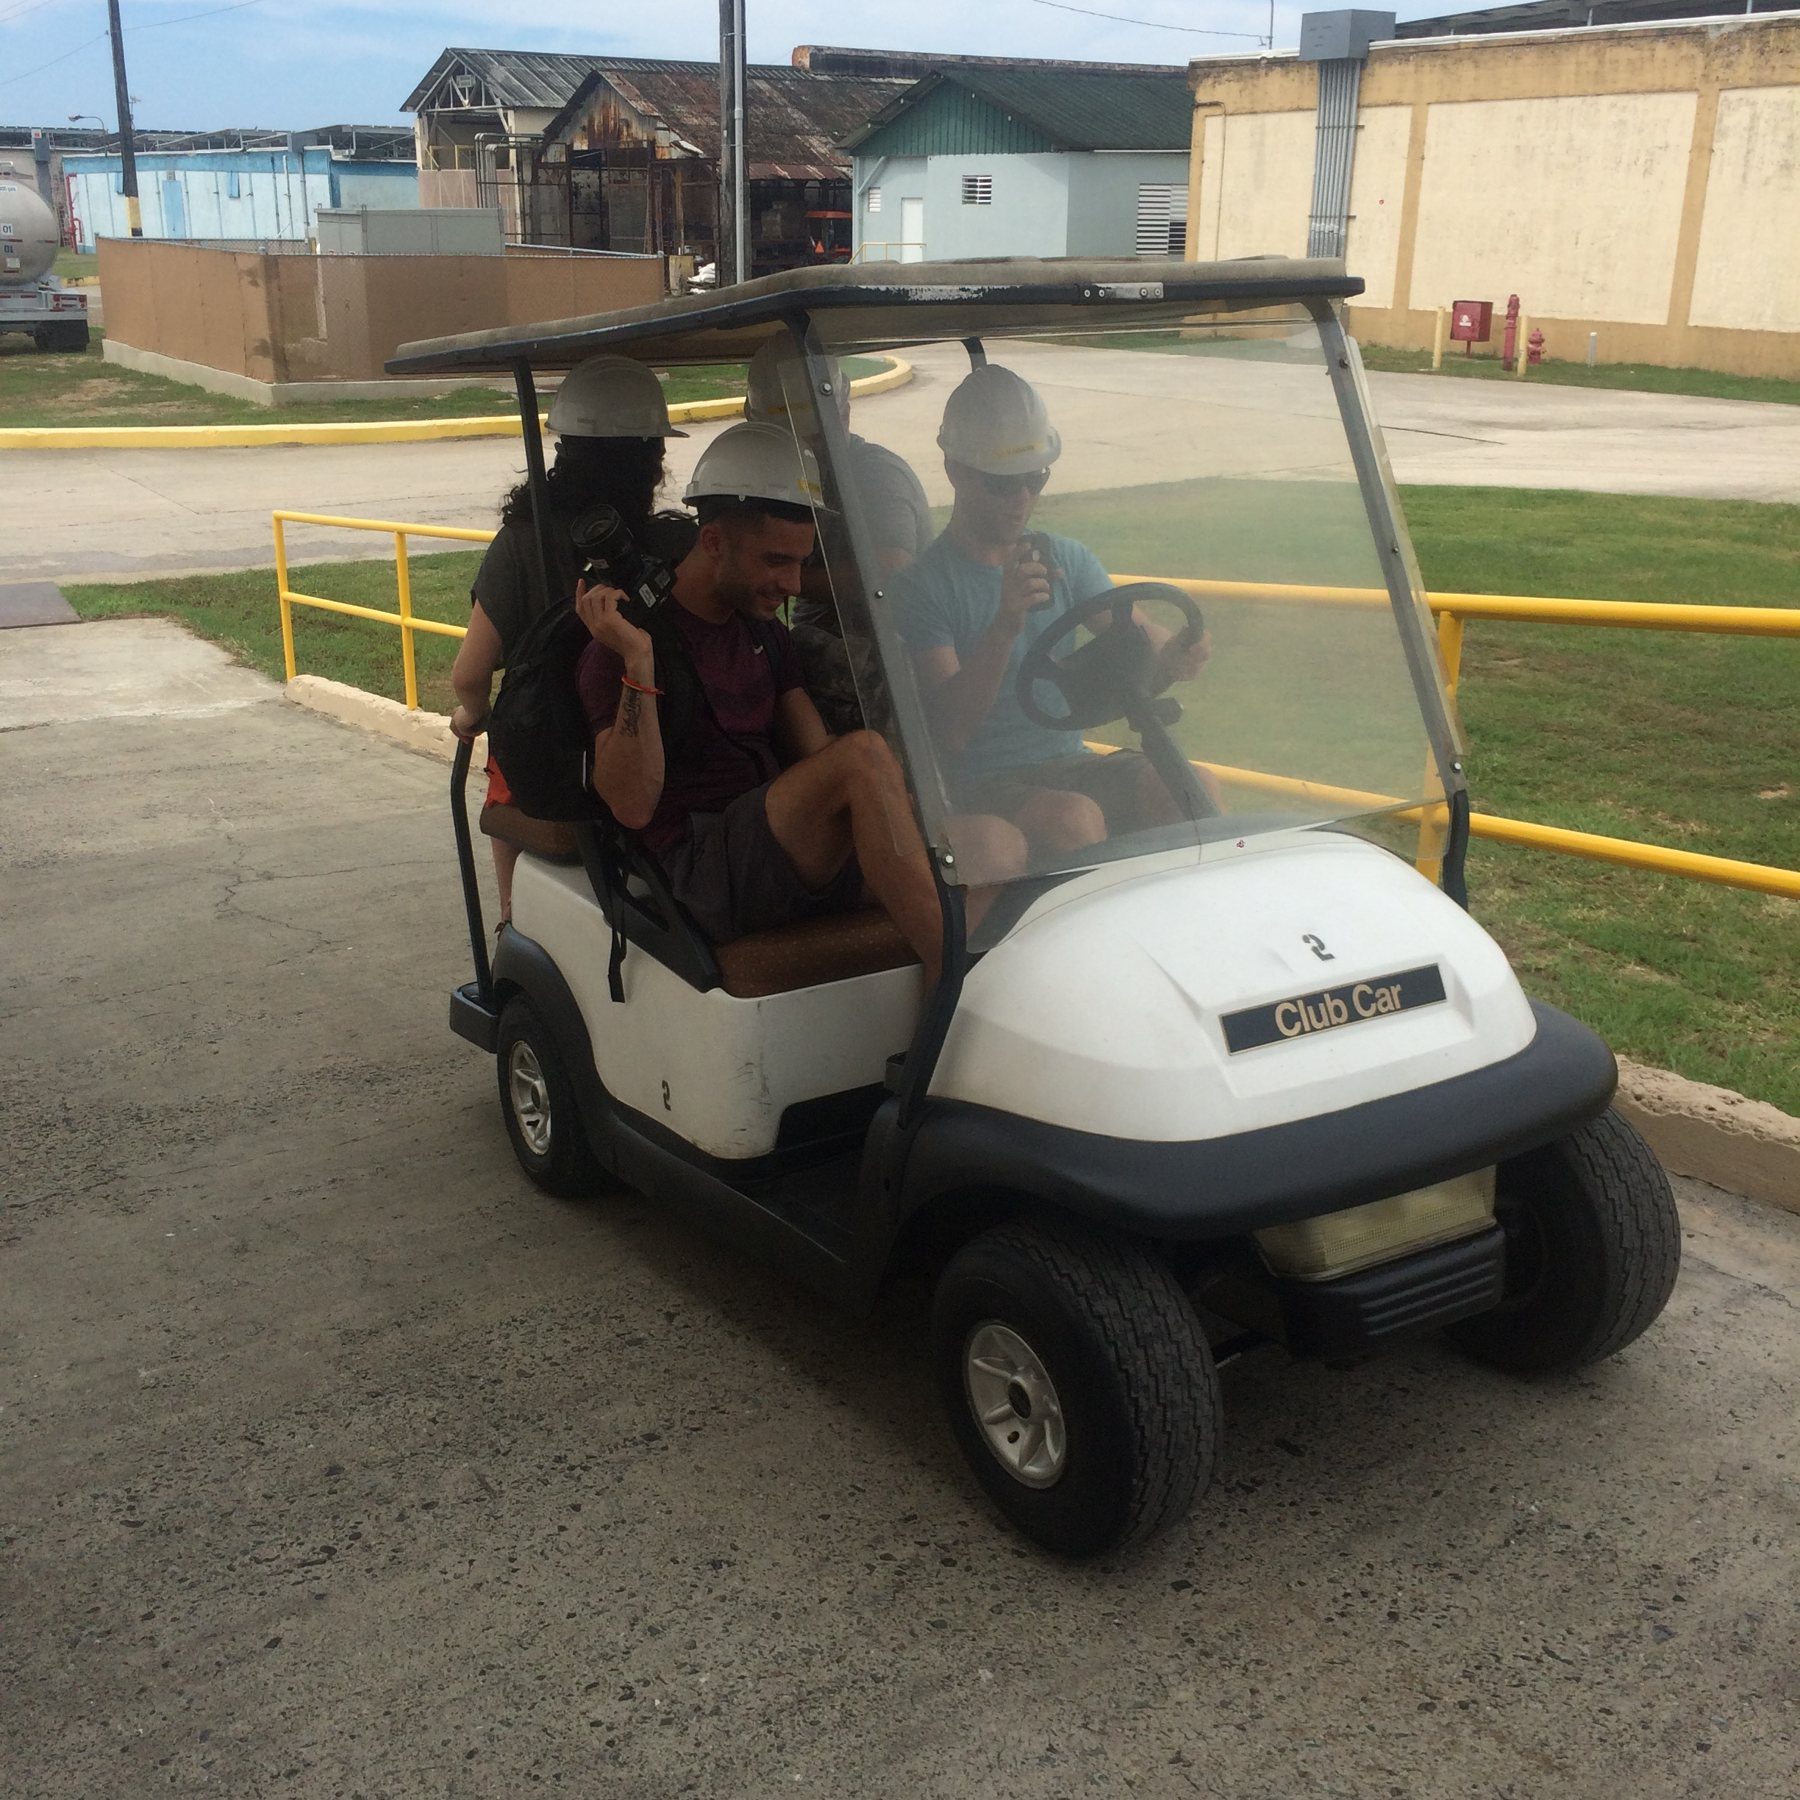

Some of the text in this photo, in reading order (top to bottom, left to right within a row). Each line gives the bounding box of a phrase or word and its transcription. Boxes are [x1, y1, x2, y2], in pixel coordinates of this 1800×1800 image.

[1302, 934, 1335, 961] 2
[1274, 983, 1402, 1037] Club Car
[662, 1080, 671, 1111] 2
